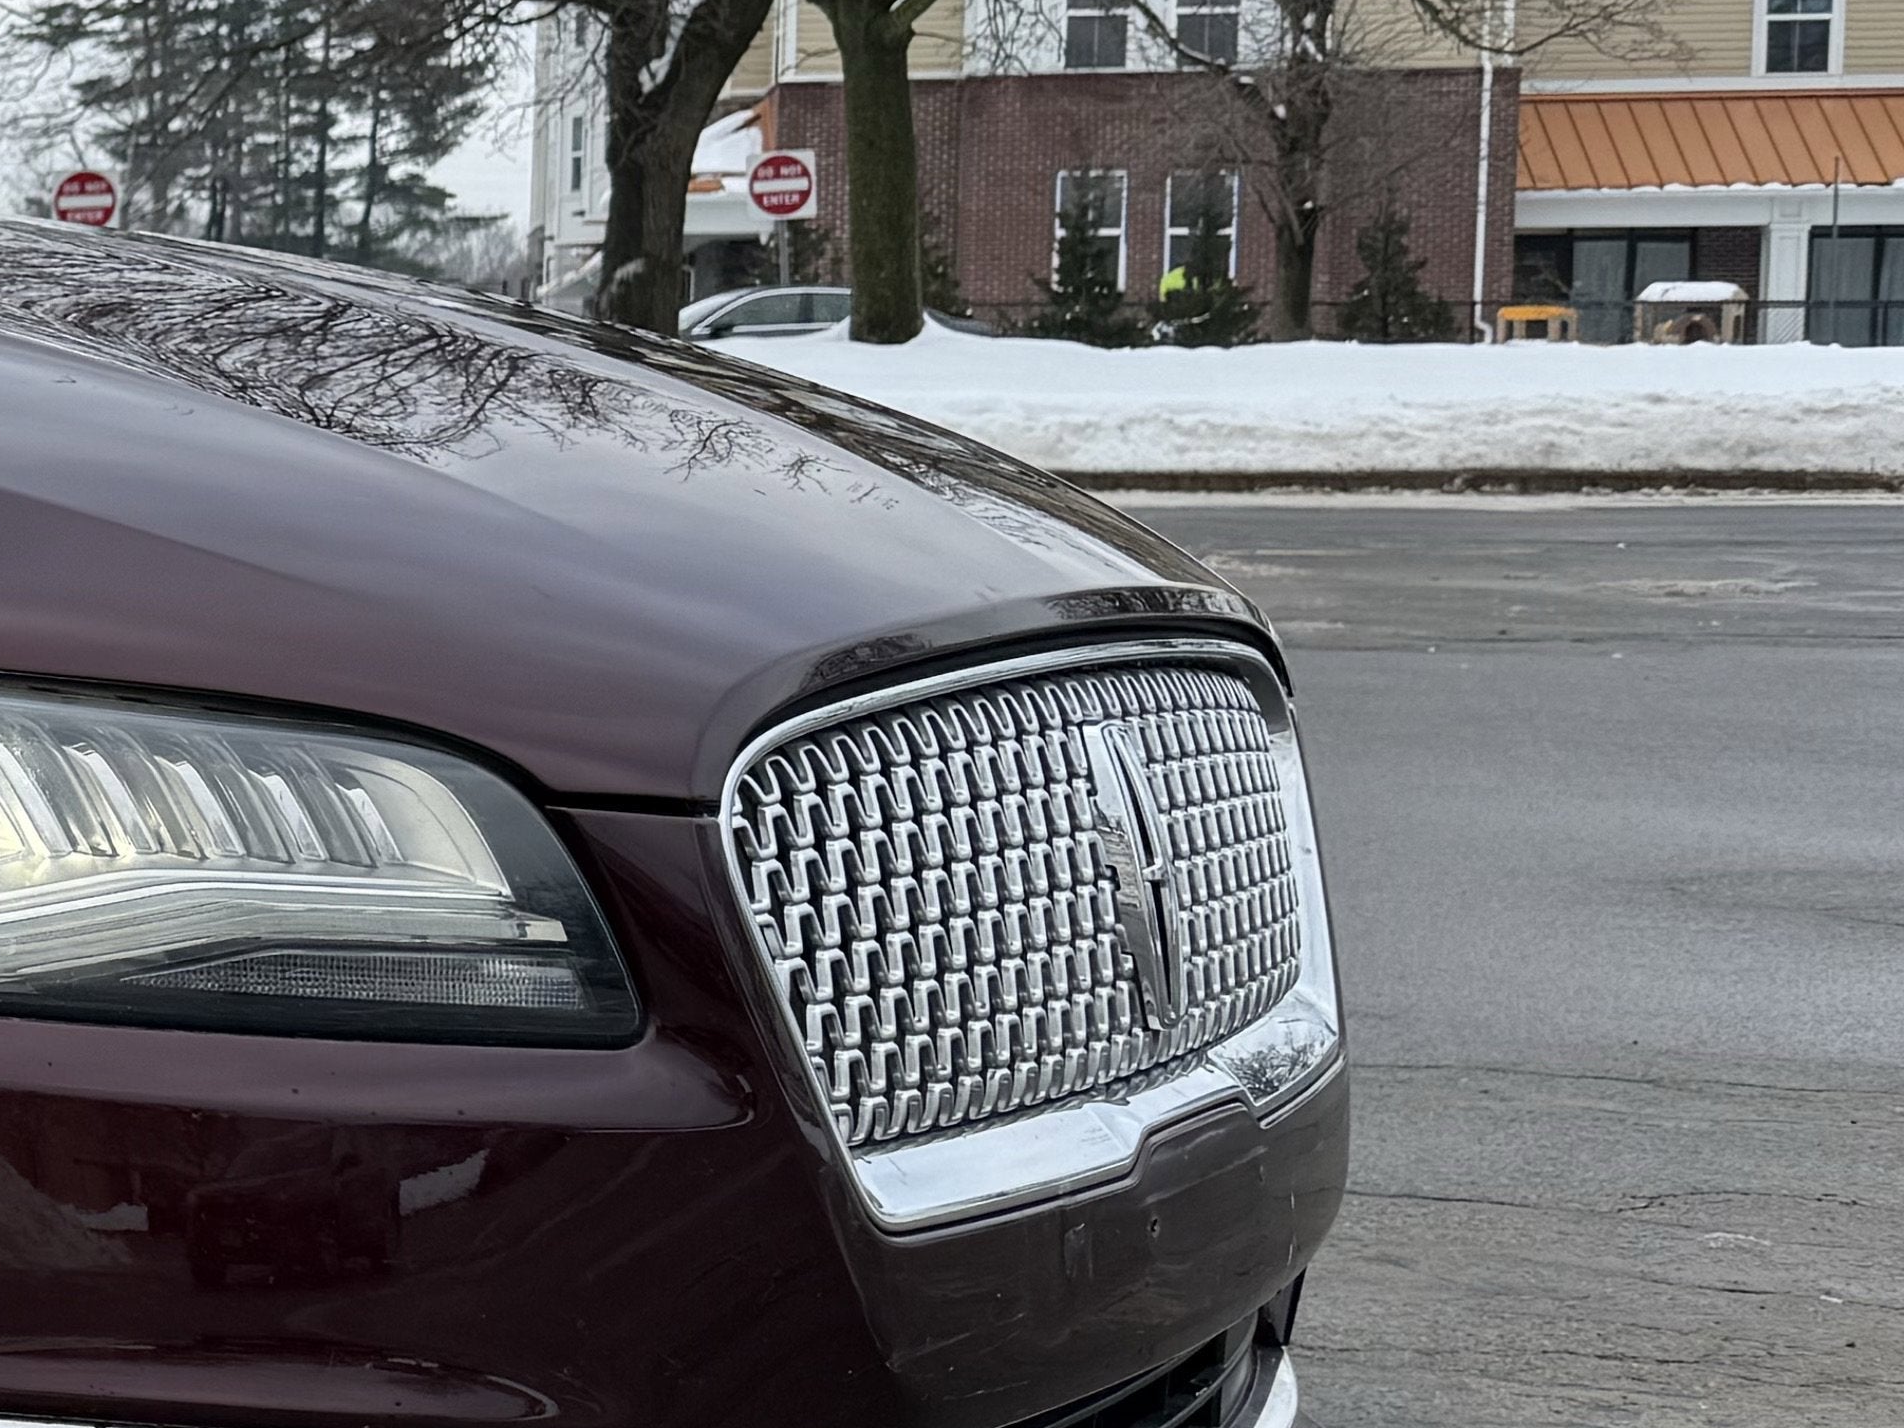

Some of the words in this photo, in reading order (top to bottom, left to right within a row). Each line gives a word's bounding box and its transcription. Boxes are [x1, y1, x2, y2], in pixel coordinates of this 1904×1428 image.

[757, 165, 774, 179] DO
[780, 163, 802, 177] NOT
[763, 192, 801, 208] ENTER
